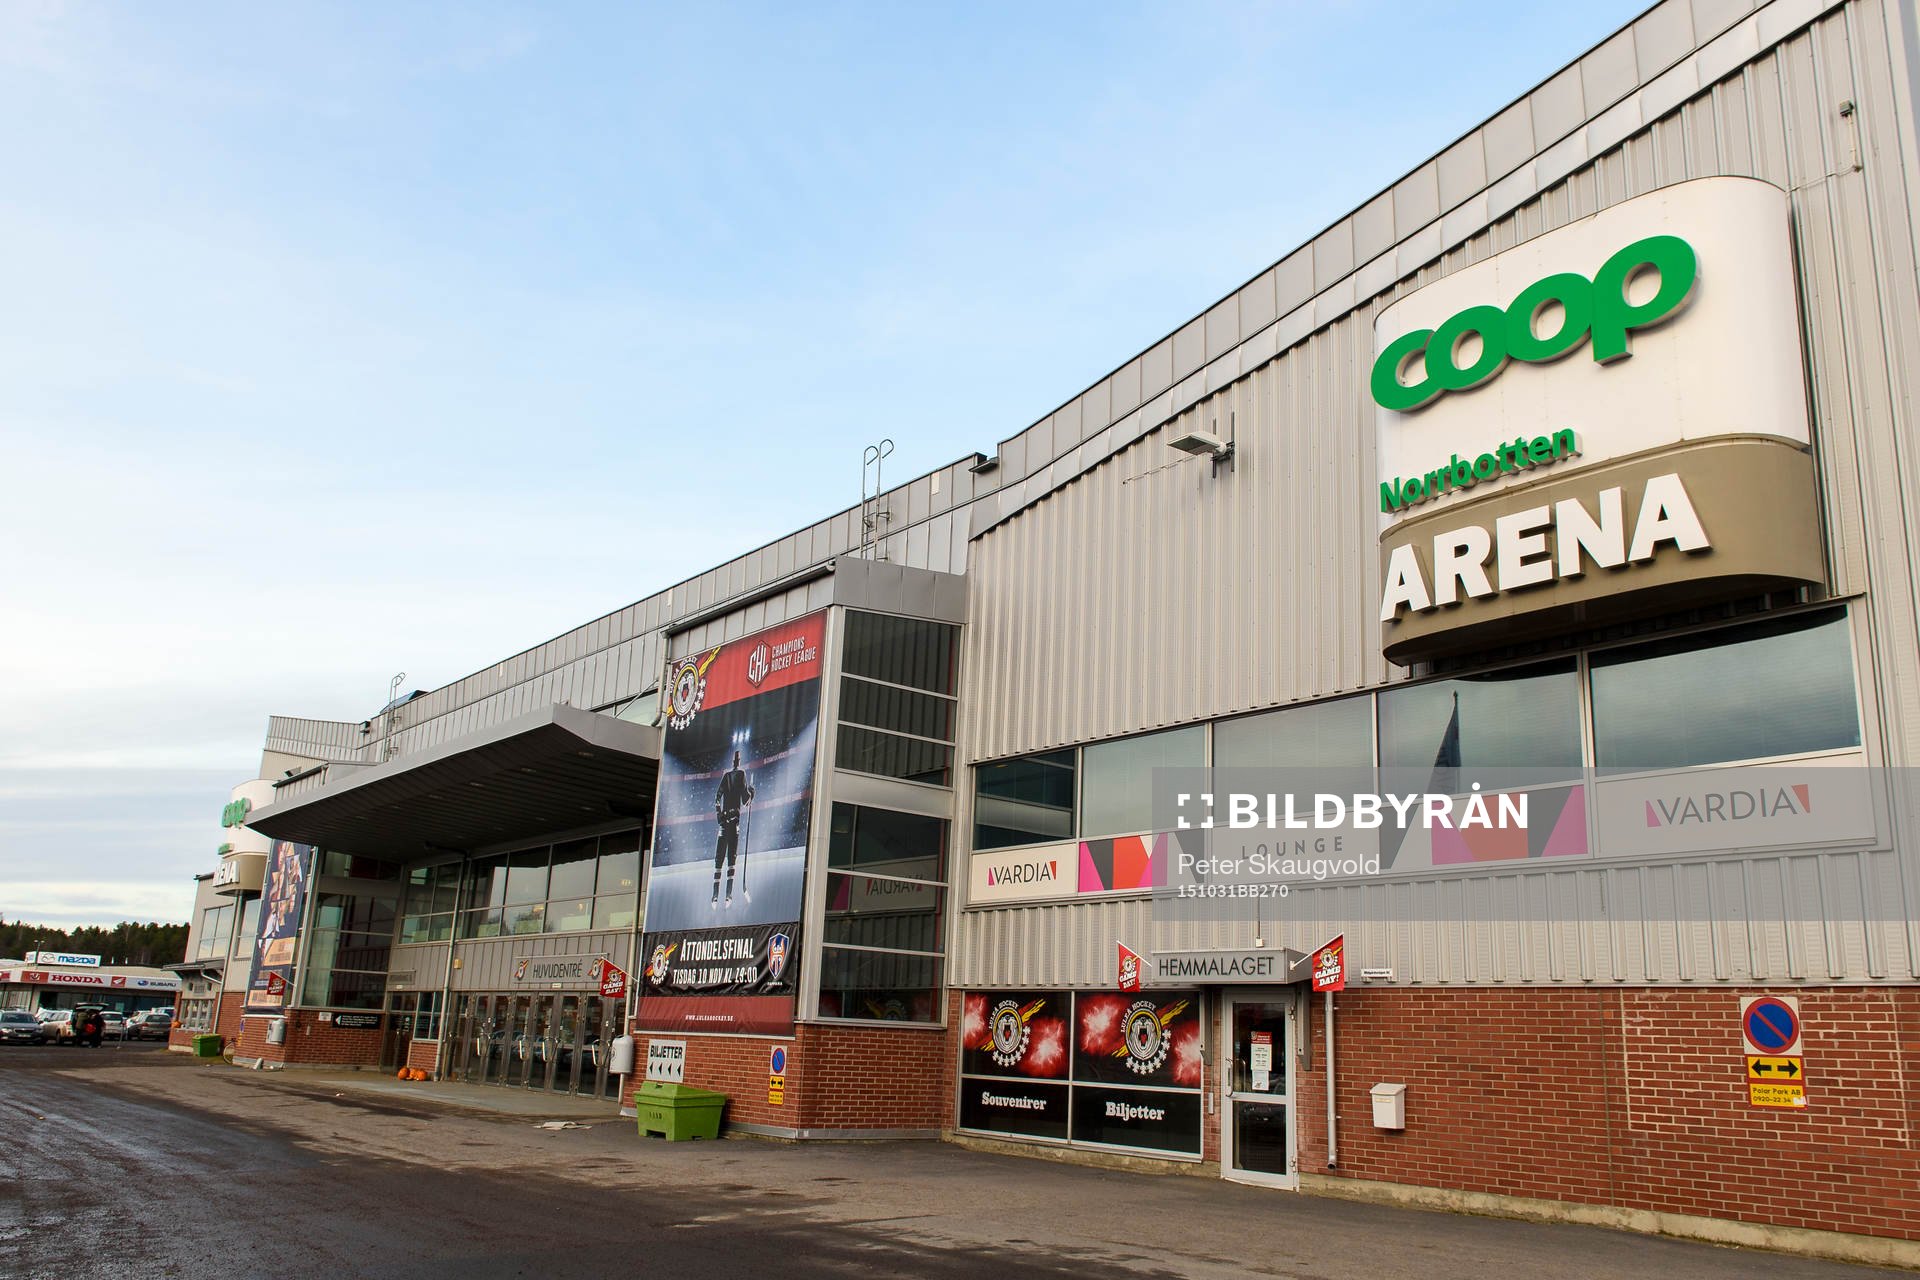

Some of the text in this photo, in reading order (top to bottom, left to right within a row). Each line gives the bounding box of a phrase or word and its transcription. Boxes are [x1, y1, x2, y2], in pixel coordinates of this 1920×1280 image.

[1371, 235, 1699, 412] coop
[1380, 427, 1583, 514] Norrbotten
[1380, 473, 1713, 624] ARENA
[772, 636, 805, 658] CHAMPIONS
[748, 645, 769, 683] CHL
[771, 647, 816, 672] HOCKEY LEAGUE
[1656, 786, 1797, 825] VARDIA
[1241, 836, 1344, 860] LOUNGE
[993, 862, 1051, 885] VARDIA
[58, 955, 96, 965] mazda
[680, 938, 754, 962] ÅTTONDELSFINAL
[533, 960, 583, 978] HUVUDENTRÉ
[672, 966, 758, 985] TISDAG 10 NOV KL 19:00
[1159, 957, 1275, 977] HEMMALAGET
[1314, 966, 1341, 979] GAME
[52, 974, 104, 984] HONDA
[1318, 974, 1339, 987] DAY!
[998, 1000, 1019, 1010] HOCKEY
[1132, 1001, 1157, 1011] HOCKEY
[650, 1045, 683, 1059] BILJETTER
[982, 1091, 1047, 1111] Souvenirer
[1772, 1088, 1789, 1096] Park
[1105, 1102, 1165, 1122] Biljetter
